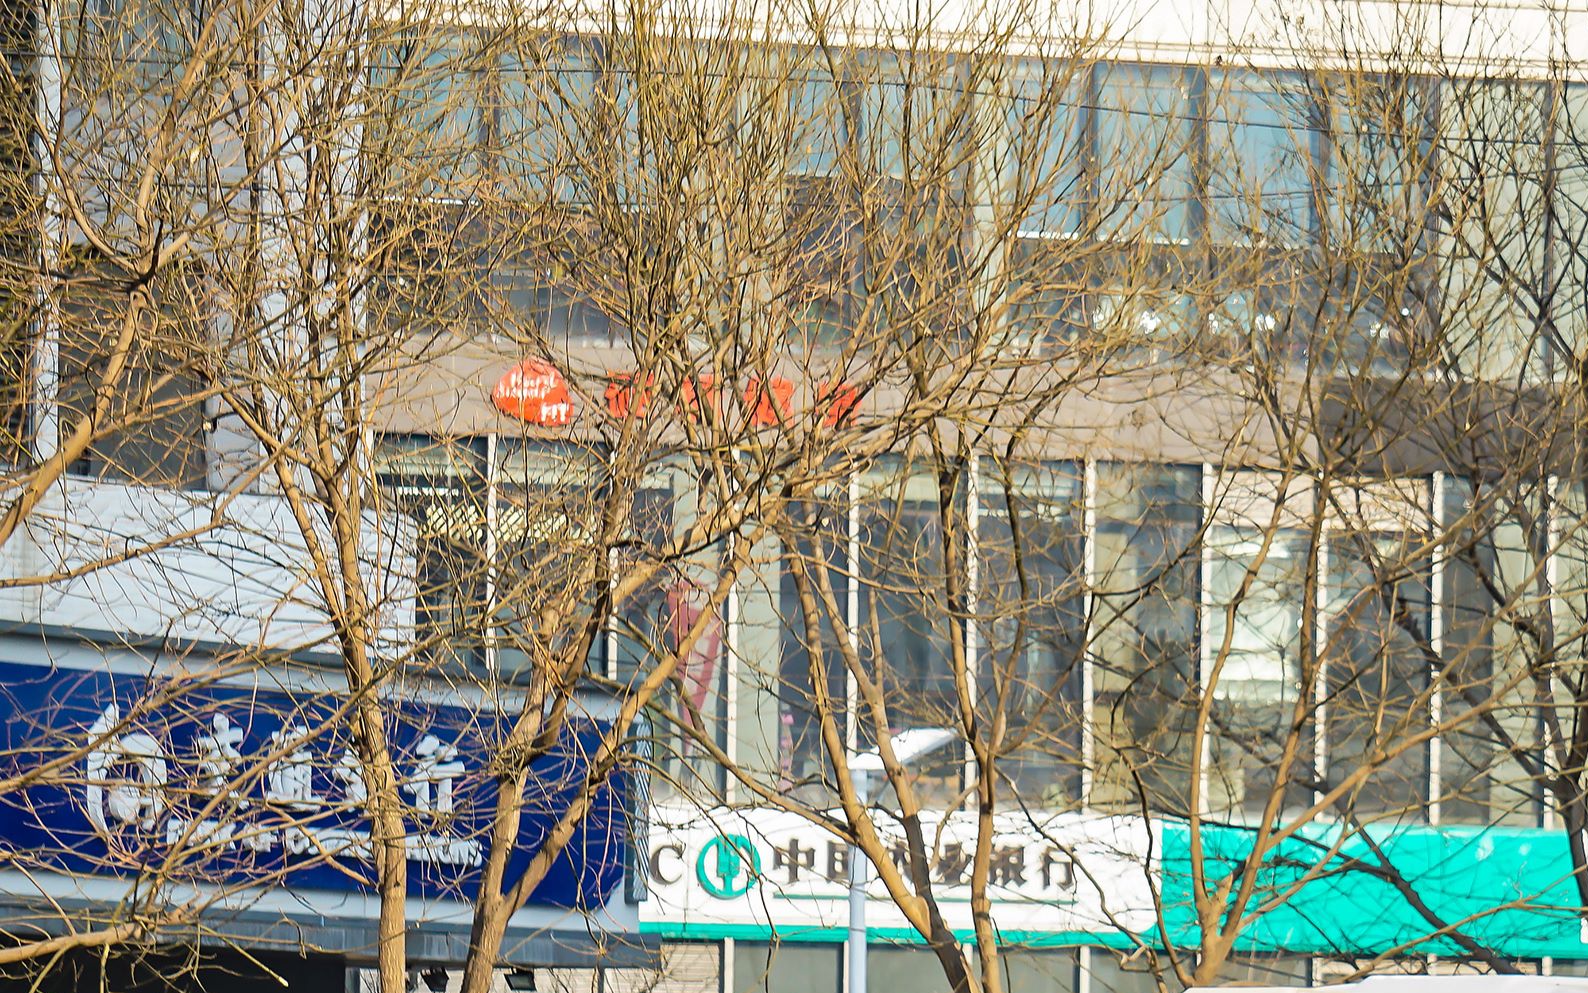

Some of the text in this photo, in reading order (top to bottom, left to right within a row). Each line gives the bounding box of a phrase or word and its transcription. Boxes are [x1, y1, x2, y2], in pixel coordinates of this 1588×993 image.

[772, 838, 1075, 891] 中国业银行
